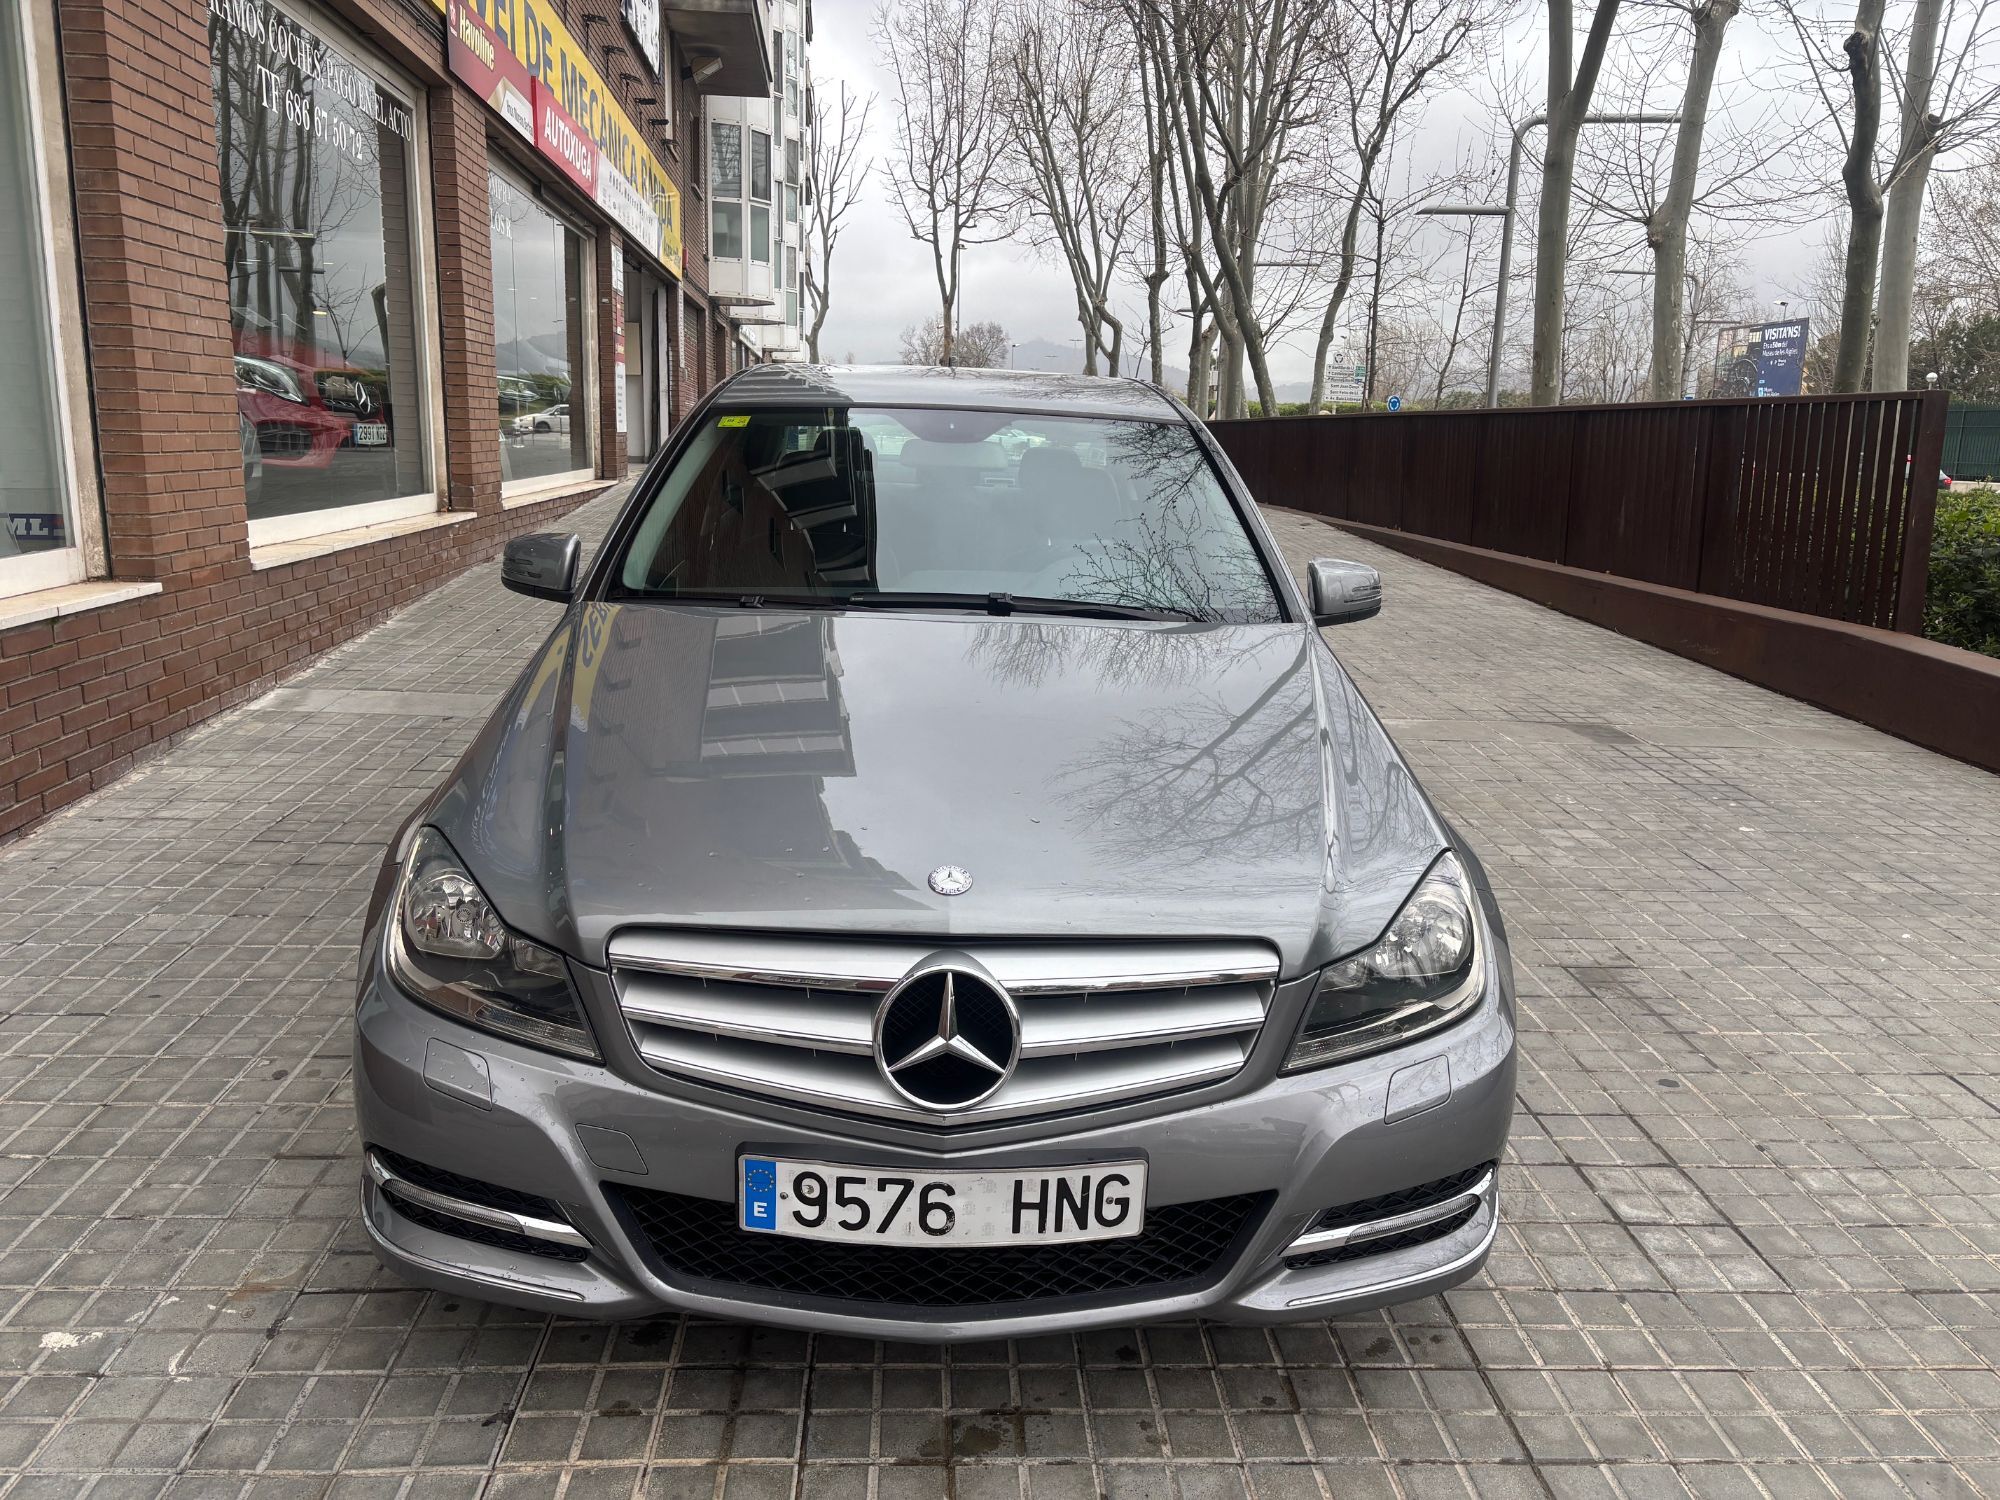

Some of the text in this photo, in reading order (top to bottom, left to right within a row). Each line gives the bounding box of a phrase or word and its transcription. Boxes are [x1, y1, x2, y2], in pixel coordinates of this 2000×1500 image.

[459, 4, 495, 72] Havoline
[524, 0, 555, 97] DE
[257, 64, 363, 160] TF 686 67 50 72
[268, 18, 324, 89] COCHES,
[326, 58, 356, 105] PAGO
[359, 80, 375, 118] EN
[374, 93, 387, 126] EL
[388, 102, 411, 141] ACTO
[544, 106, 592, 182] AUTOXUGA
[1765, 325, 1801, 340] VISITA'NS!
[754, 1171, 1131, 1236] E 9576 HNG
